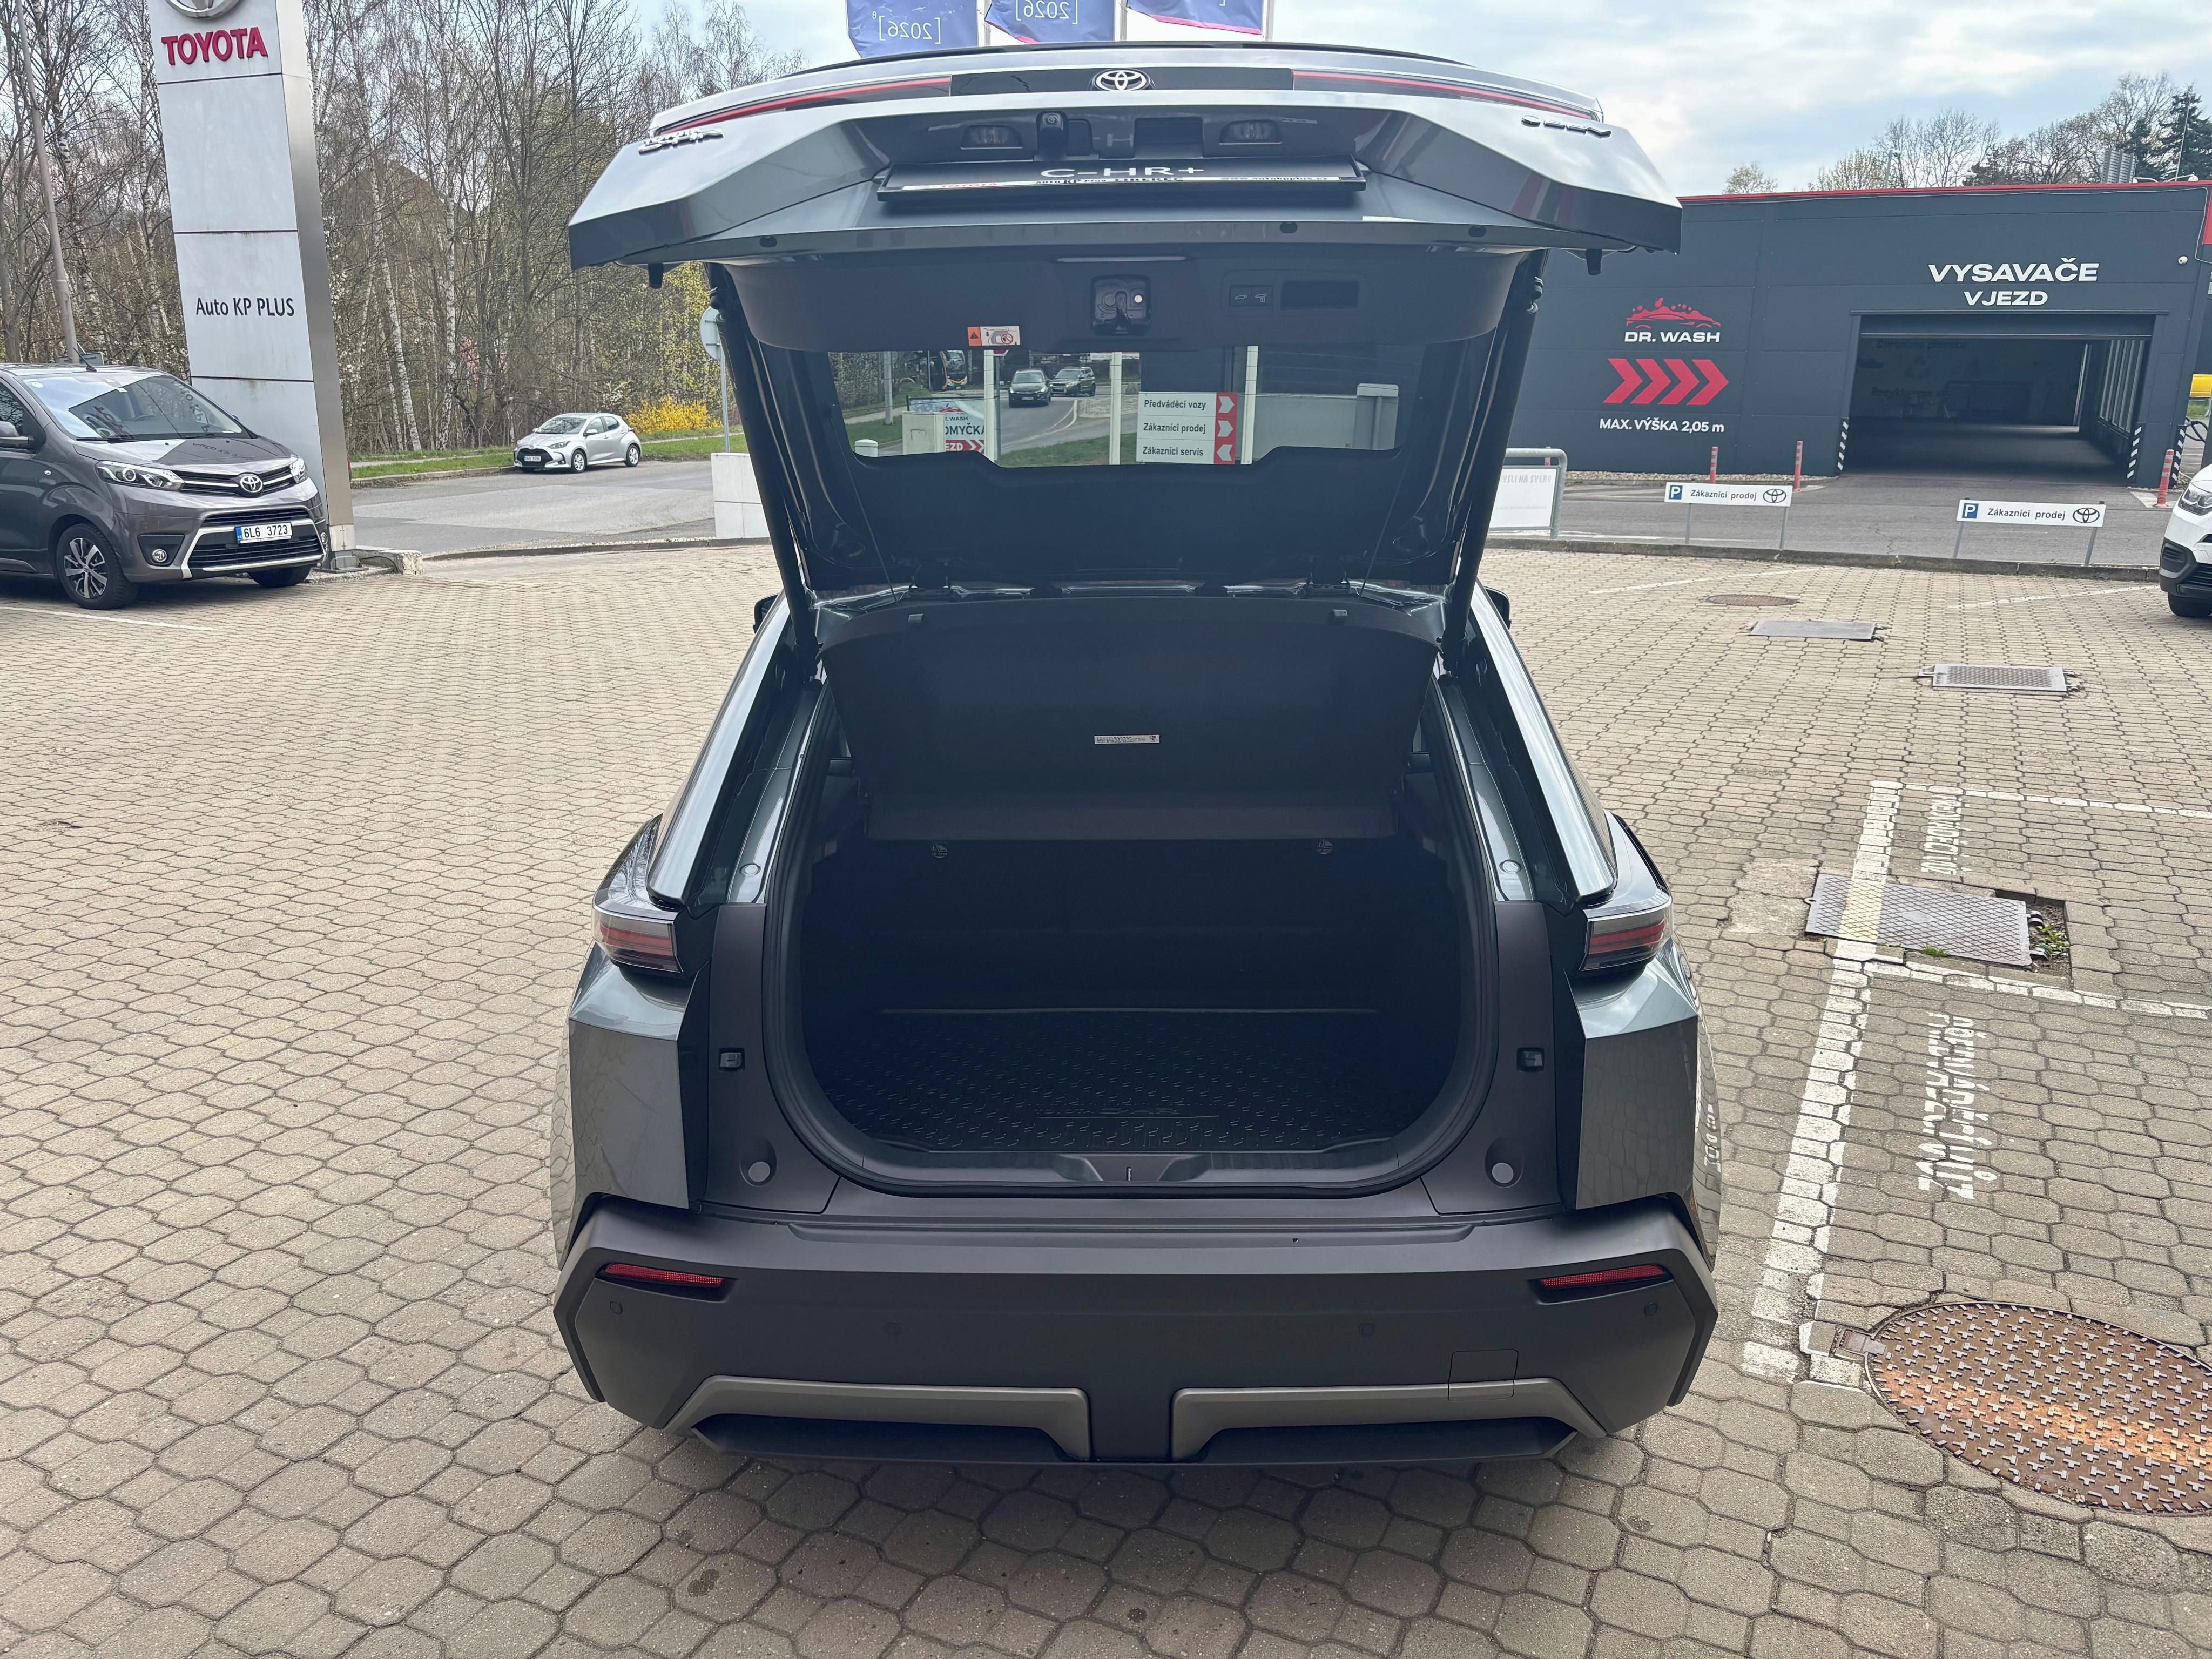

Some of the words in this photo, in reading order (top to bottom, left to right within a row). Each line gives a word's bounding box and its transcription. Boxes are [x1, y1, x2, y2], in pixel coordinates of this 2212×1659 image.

[161, 27, 268, 65] TOYOTA
[1041, 167, 1204, 177] C-HR+
[1928, 258, 2099, 282] VYSAVAČE
[196, 298, 228, 315] Auto
[233, 298, 251, 316] KP
[257, 298, 294, 316] PLUS
[1624, 332, 1656, 342] DR.
[1660, 332, 1721, 342] WASH
[1144, 400, 1186, 408] Předváděcí
[1189, 402, 1206, 410] vozy
[1143, 423, 1179, 431] Zákazníci
[1181, 424, 1206, 434] prodej
[1599, 419, 1632, 429] MAX.
[1634, 417, 1678, 431] VÝŠKA
[1681, 421, 1709, 433] 2,05
[1712, 423, 1724, 432] m
[1142, 447, 1178, 455] Zákazníci
[1181, 448, 1204, 456] servis
[1670, 487, 1681, 498] P
[1691, 489, 1727, 498] Zákazníci
[1731, 492, 1757, 501] prodej
[1964, 505, 1975, 517] P
[1987, 508, 2030, 517] Zákazníci
[2035, 511, 2066, 521] prodej
[244, 527, 261, 538] 6L6
[267, 524, 288, 536] 3723
